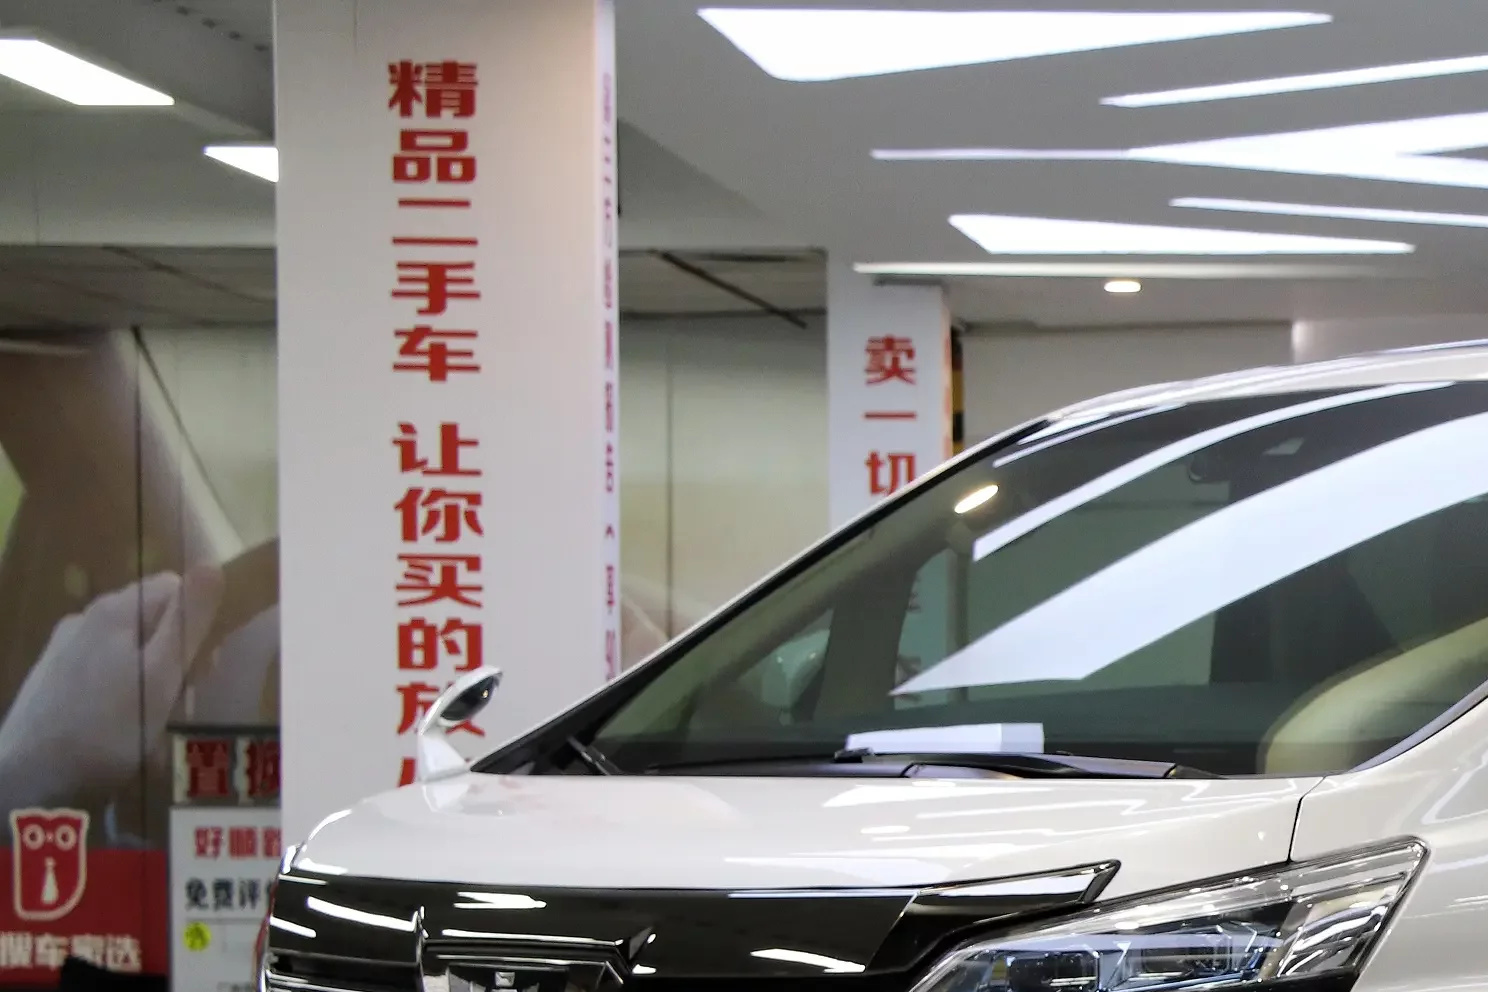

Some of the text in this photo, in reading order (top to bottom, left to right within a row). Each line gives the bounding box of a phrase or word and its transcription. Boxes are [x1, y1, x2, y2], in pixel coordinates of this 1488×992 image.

[388, 60, 486, 788] 精品二手车 让你买的放
[864, 334, 917, 497] 卖一切
[185, 878, 274, 910] 免费评
